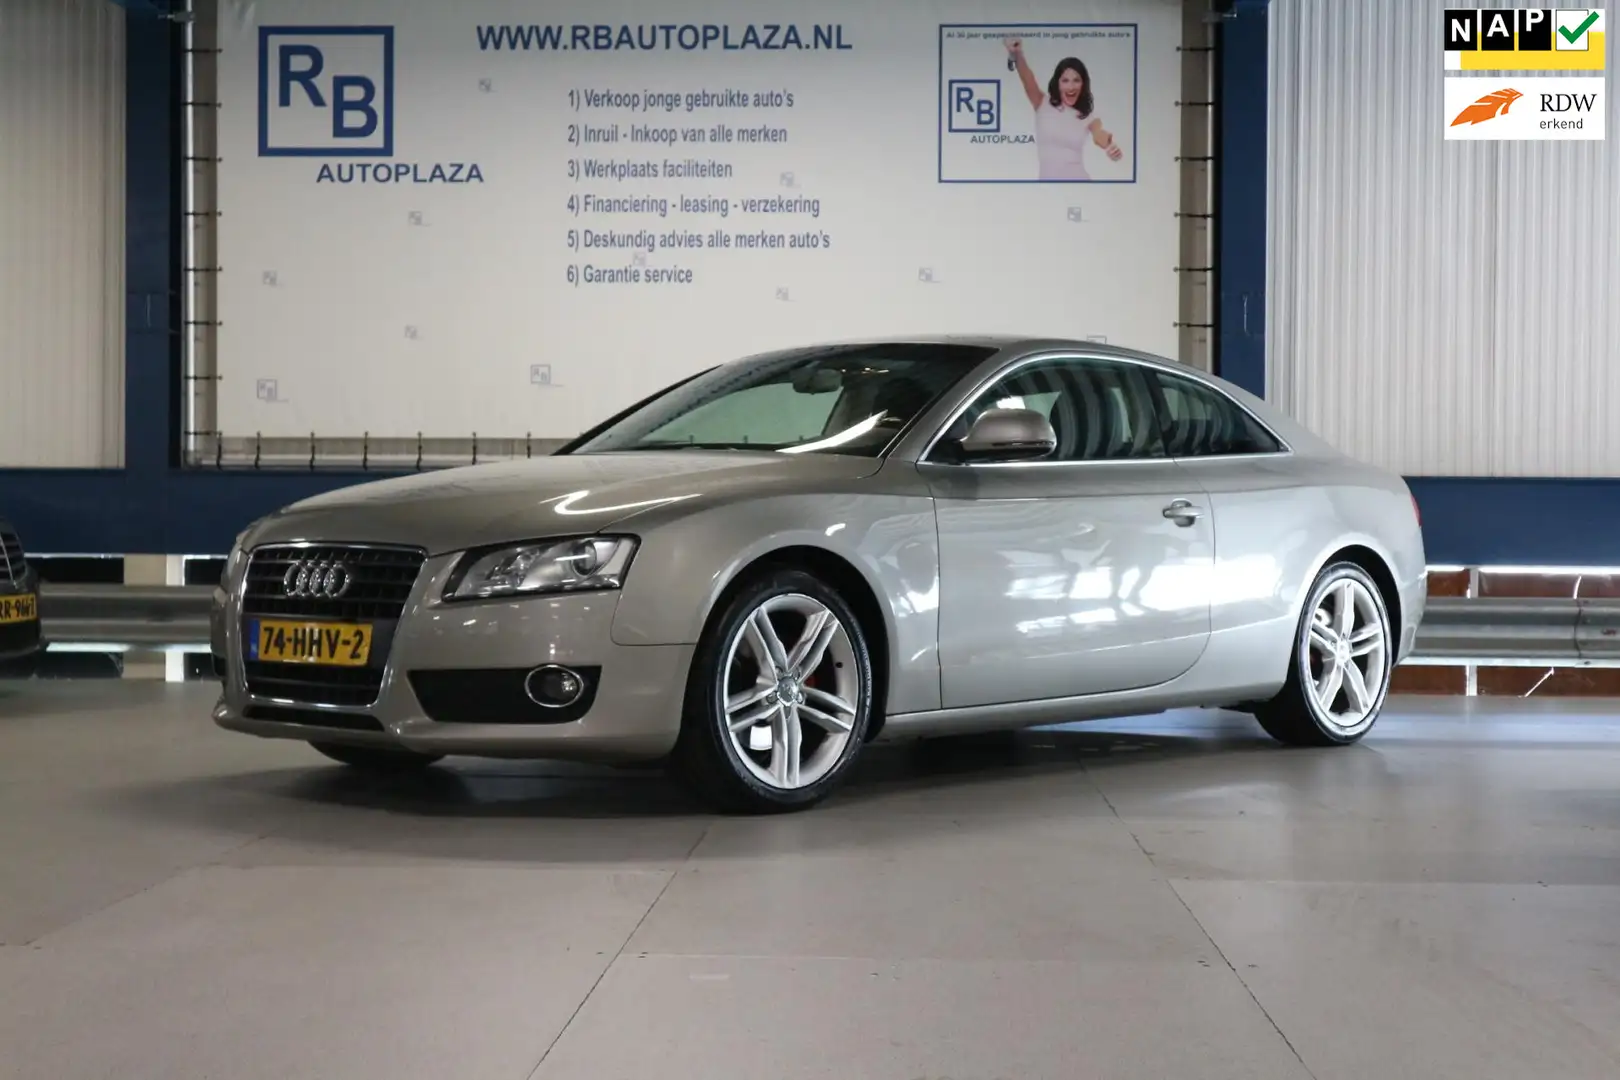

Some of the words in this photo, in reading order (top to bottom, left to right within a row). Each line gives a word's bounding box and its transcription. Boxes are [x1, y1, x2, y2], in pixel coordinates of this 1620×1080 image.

[476, 25, 853, 50] WWW.RBAUTOPLAZA.NL
[278, 44, 378, 138] RB
[568, 89, 581, 112] 1)
[584, 89, 641, 112] Verkoop
[642, 89, 681, 112] jonge
[685, 89, 749, 112] gebruikte
[753, 89, 794, 108] auto's
[956, 87, 995, 125] RB
[567, 124, 580, 147] 2)
[584, 124, 618, 142] Inruil
[631, 124, 678, 146] Inkoop
[681, 128, 706, 143] van
[709, 124, 733, 143] alle
[737, 124, 787, 143] merken
[970, 134, 1035, 144] AUTOPLAZA
[316, 163, 484, 183] AUTOPLAZA
[567, 159, 580, 182] 3)
[584, 159, 659, 182] Werkplaats
[662, 159, 732, 178] faciliteiten
[567, 195, 580, 217] 4)
[584, 194, 667, 217] Financiering
[680, 194, 729, 218] leasing
[741, 194, 820, 218] verzekering
[567, 230, 580, 252] 5)
[584, 229, 656, 253] Deskundig
[659, 229, 703, 248] advies
[707, 229, 731, 248] alle
[735, 229, 785, 248] merken
[789, 229, 830, 248] auto's
[566, 265, 580, 286] 6)
[583, 264, 641, 283] Garantie
[644, 264, 693, 284] service
[263, 626, 364, 660] 74-HHV-2
